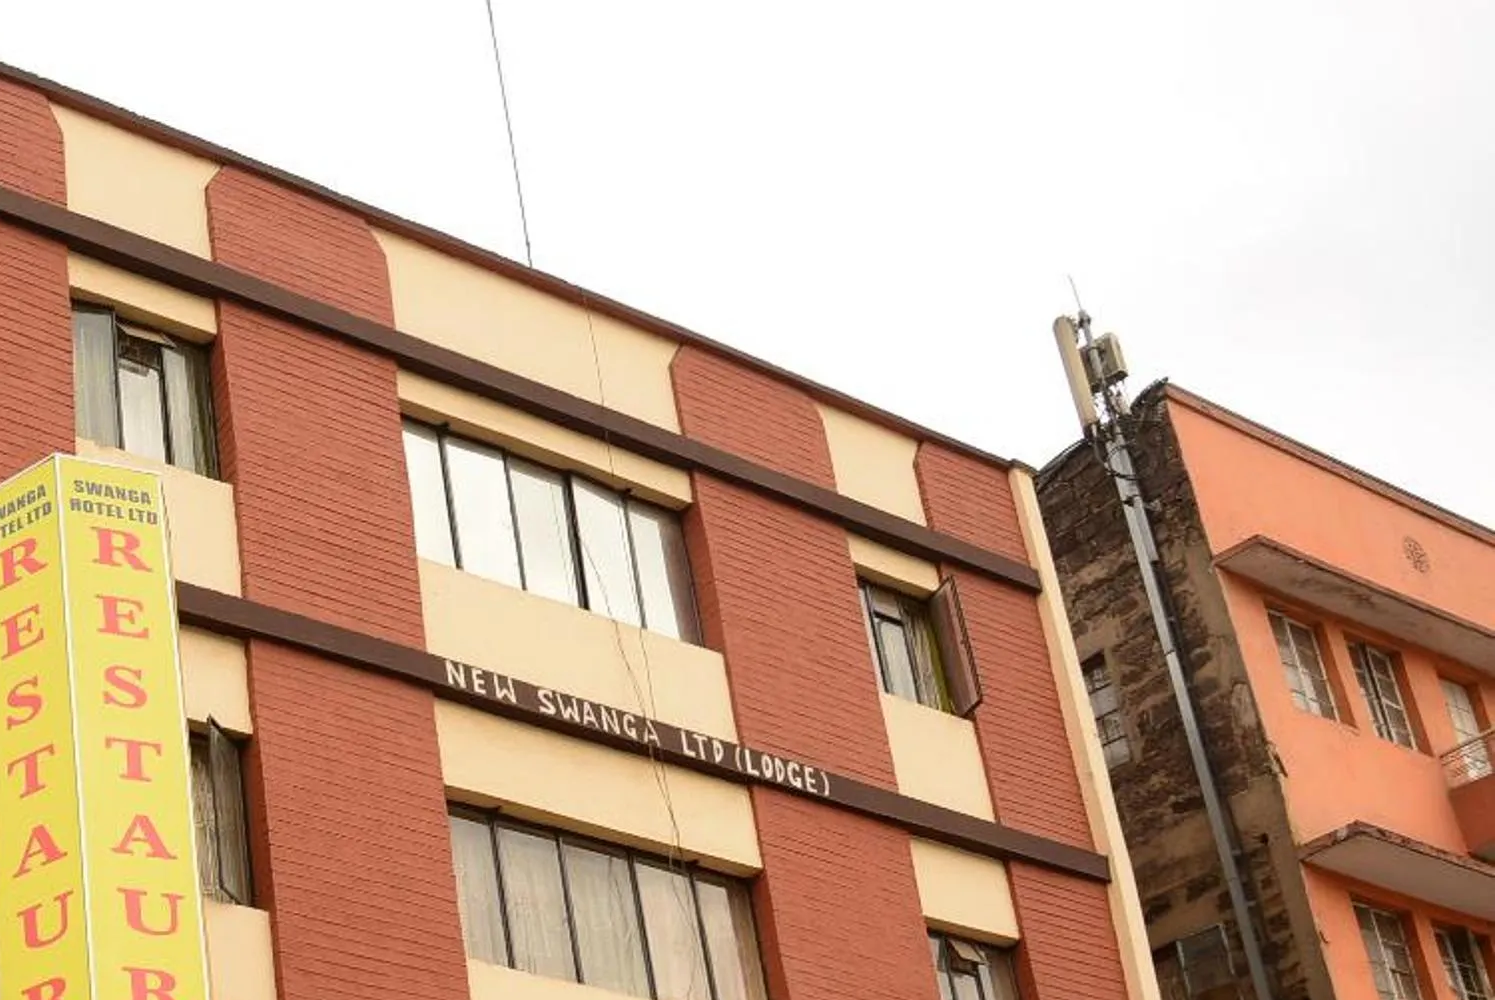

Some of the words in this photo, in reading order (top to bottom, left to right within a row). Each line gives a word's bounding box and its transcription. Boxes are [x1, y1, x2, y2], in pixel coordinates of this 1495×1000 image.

[73, 479, 152, 505] SWANGA
[26, 501, 52, 526] LTD
[69, 498, 124, 519] HOTEL
[128, 507, 159, 526] LTD
[443, 659, 518, 704] NEW
[537, 688, 660, 748] SWANGA
[680, 729, 724, 763] LTD
[734, 747, 831, 797] (LODGE)
